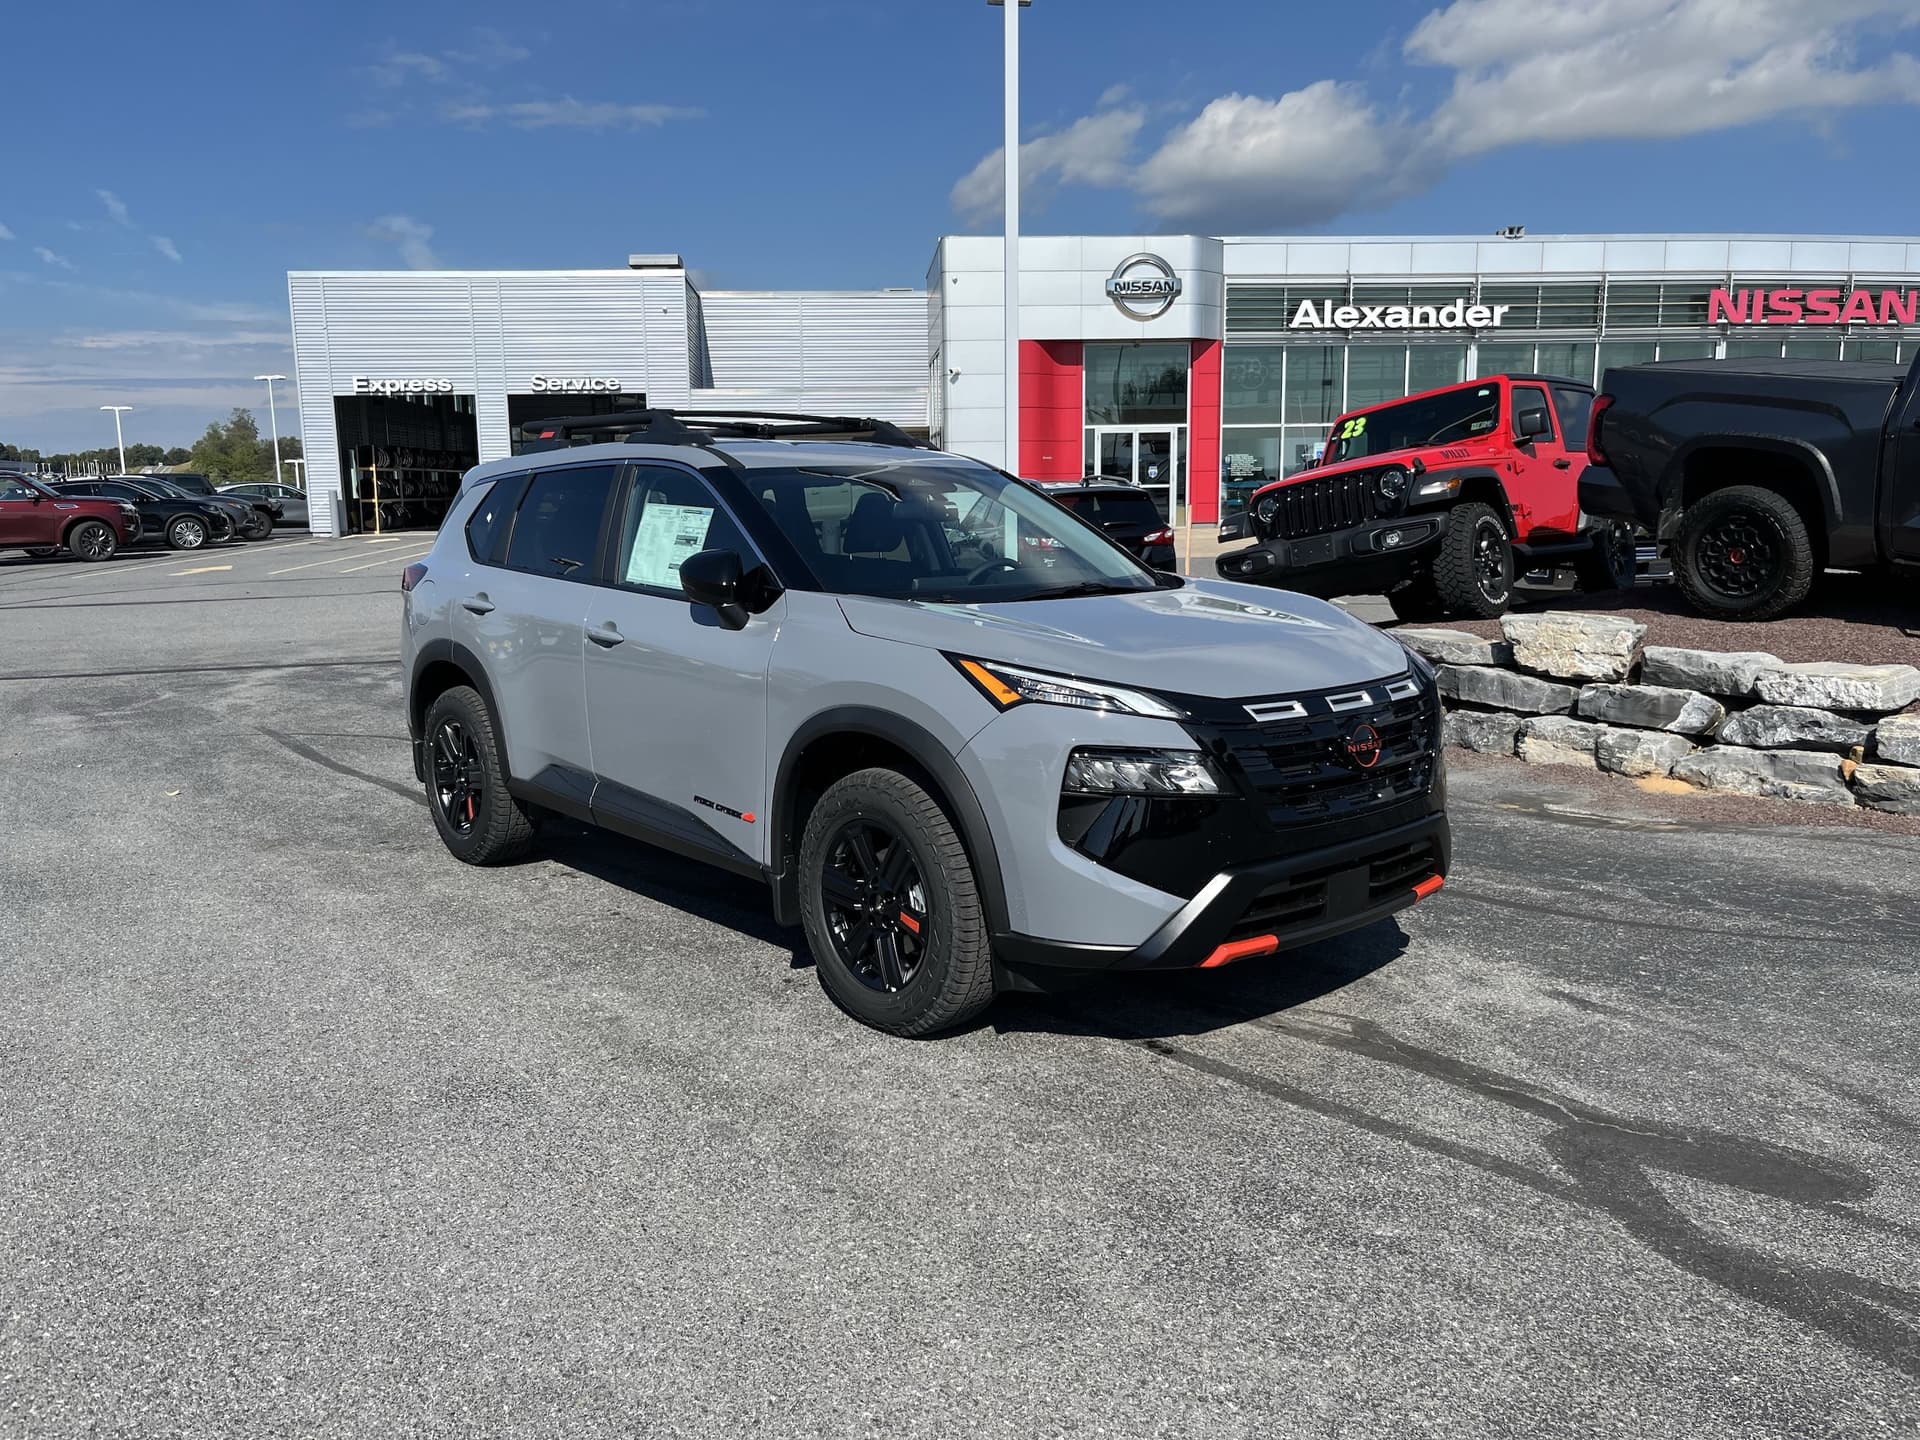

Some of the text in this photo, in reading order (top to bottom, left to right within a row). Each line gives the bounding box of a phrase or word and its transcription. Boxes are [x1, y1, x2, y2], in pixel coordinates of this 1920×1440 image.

[1114, 281, 1175, 292] NISSAN
[1289, 298, 1509, 328] Alexander
[1708, 289, 1918, 324] NISSAN
[352, 375, 453, 396] Express
[531, 374, 621, 391] Service
[1340, 417, 1367, 440] 23
